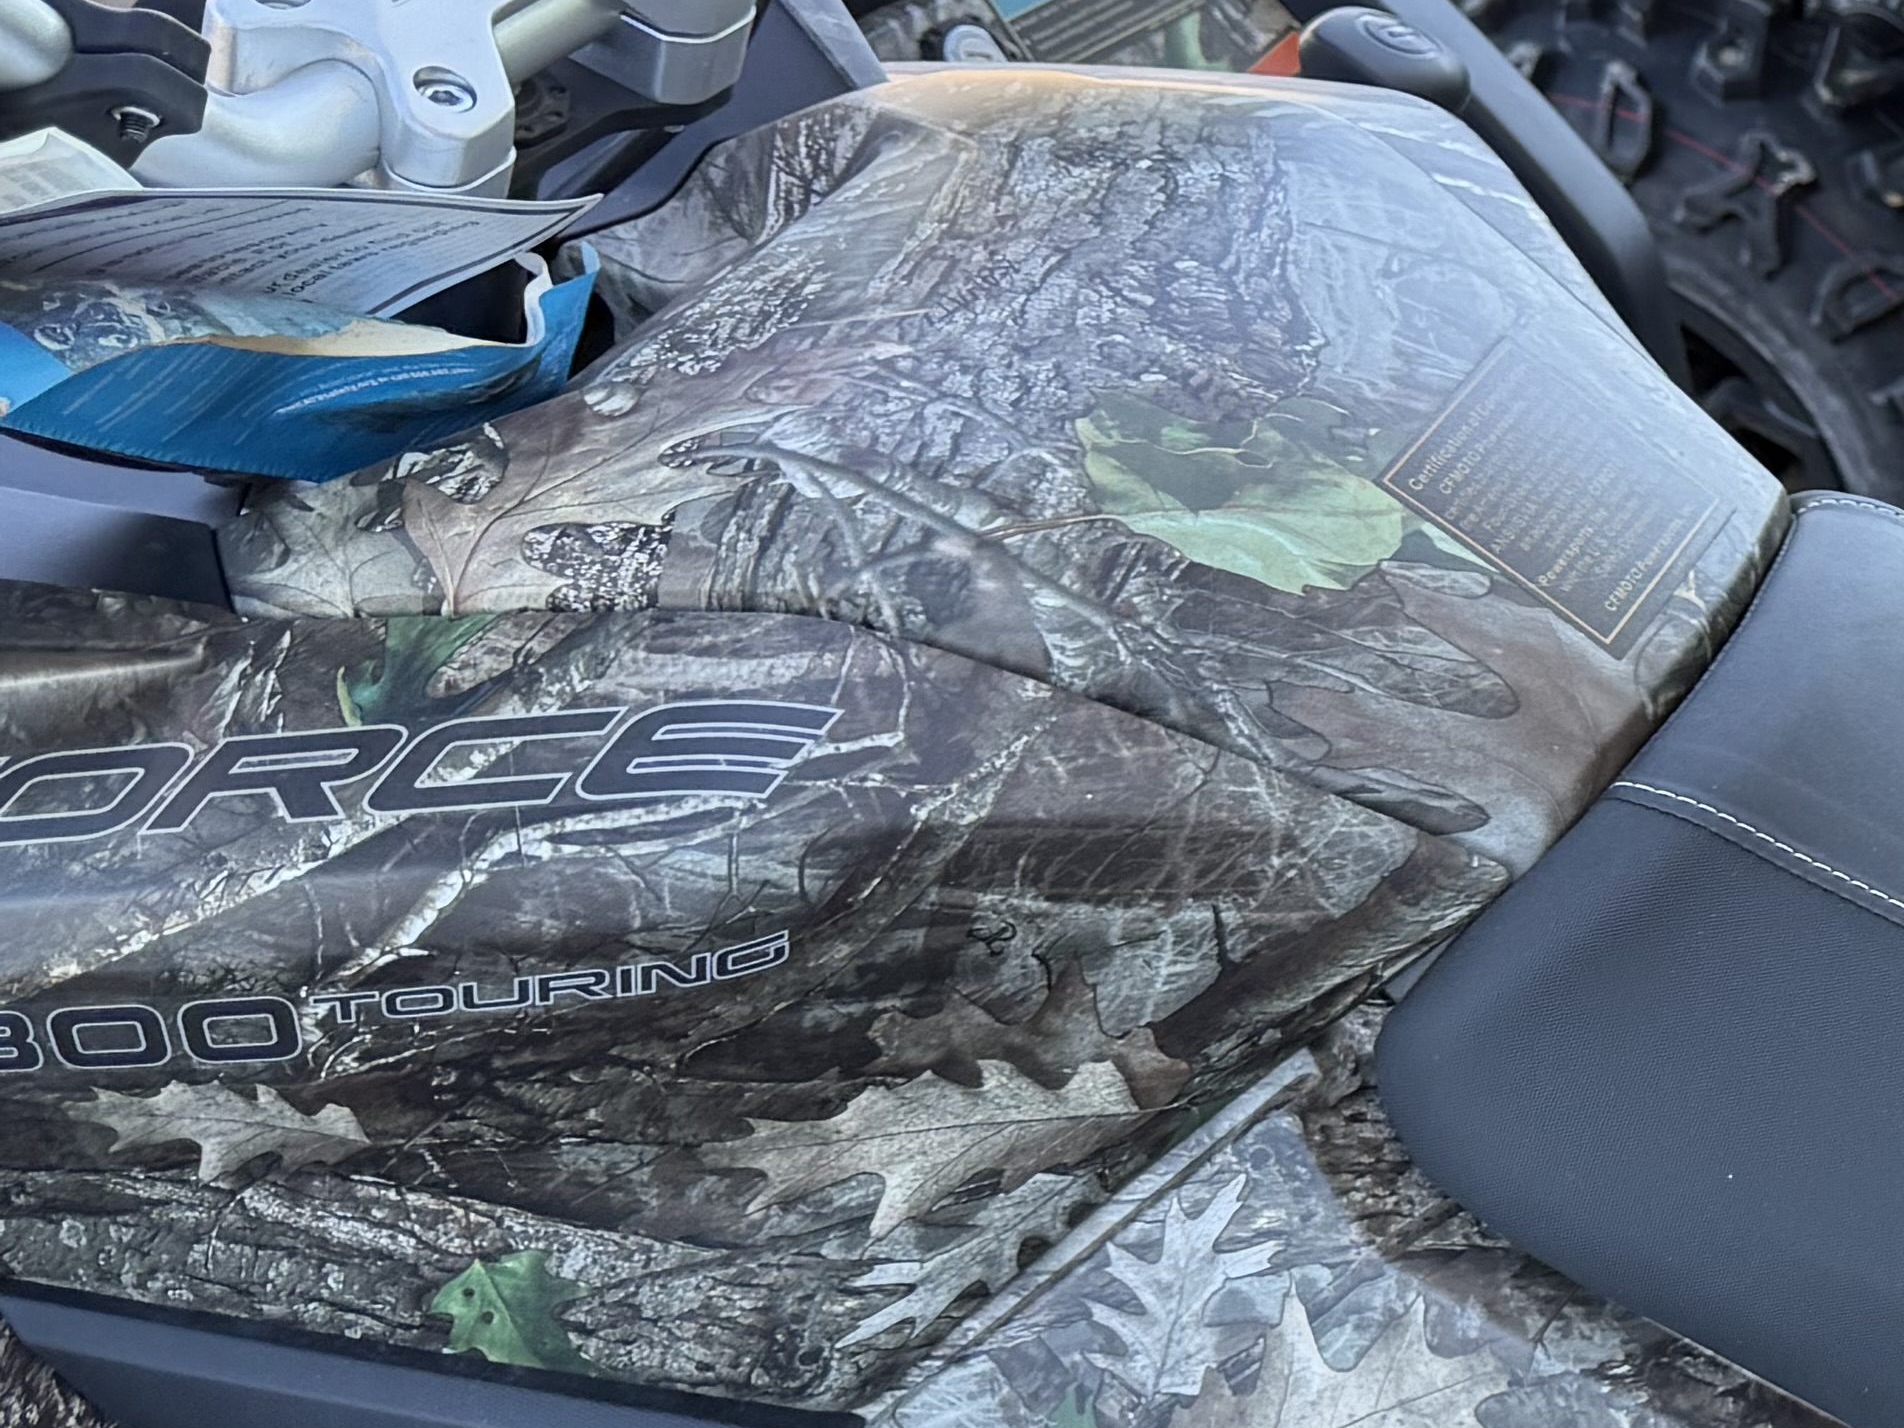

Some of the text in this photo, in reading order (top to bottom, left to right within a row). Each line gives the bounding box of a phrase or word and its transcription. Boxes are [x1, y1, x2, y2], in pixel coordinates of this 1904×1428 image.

[1408, 424, 1474, 491] Certification
[1604, 566, 1644, 612] CFMOTO
[0, 698, 843, 846] ORCE
[312, 931, 791, 1025] TOURING
